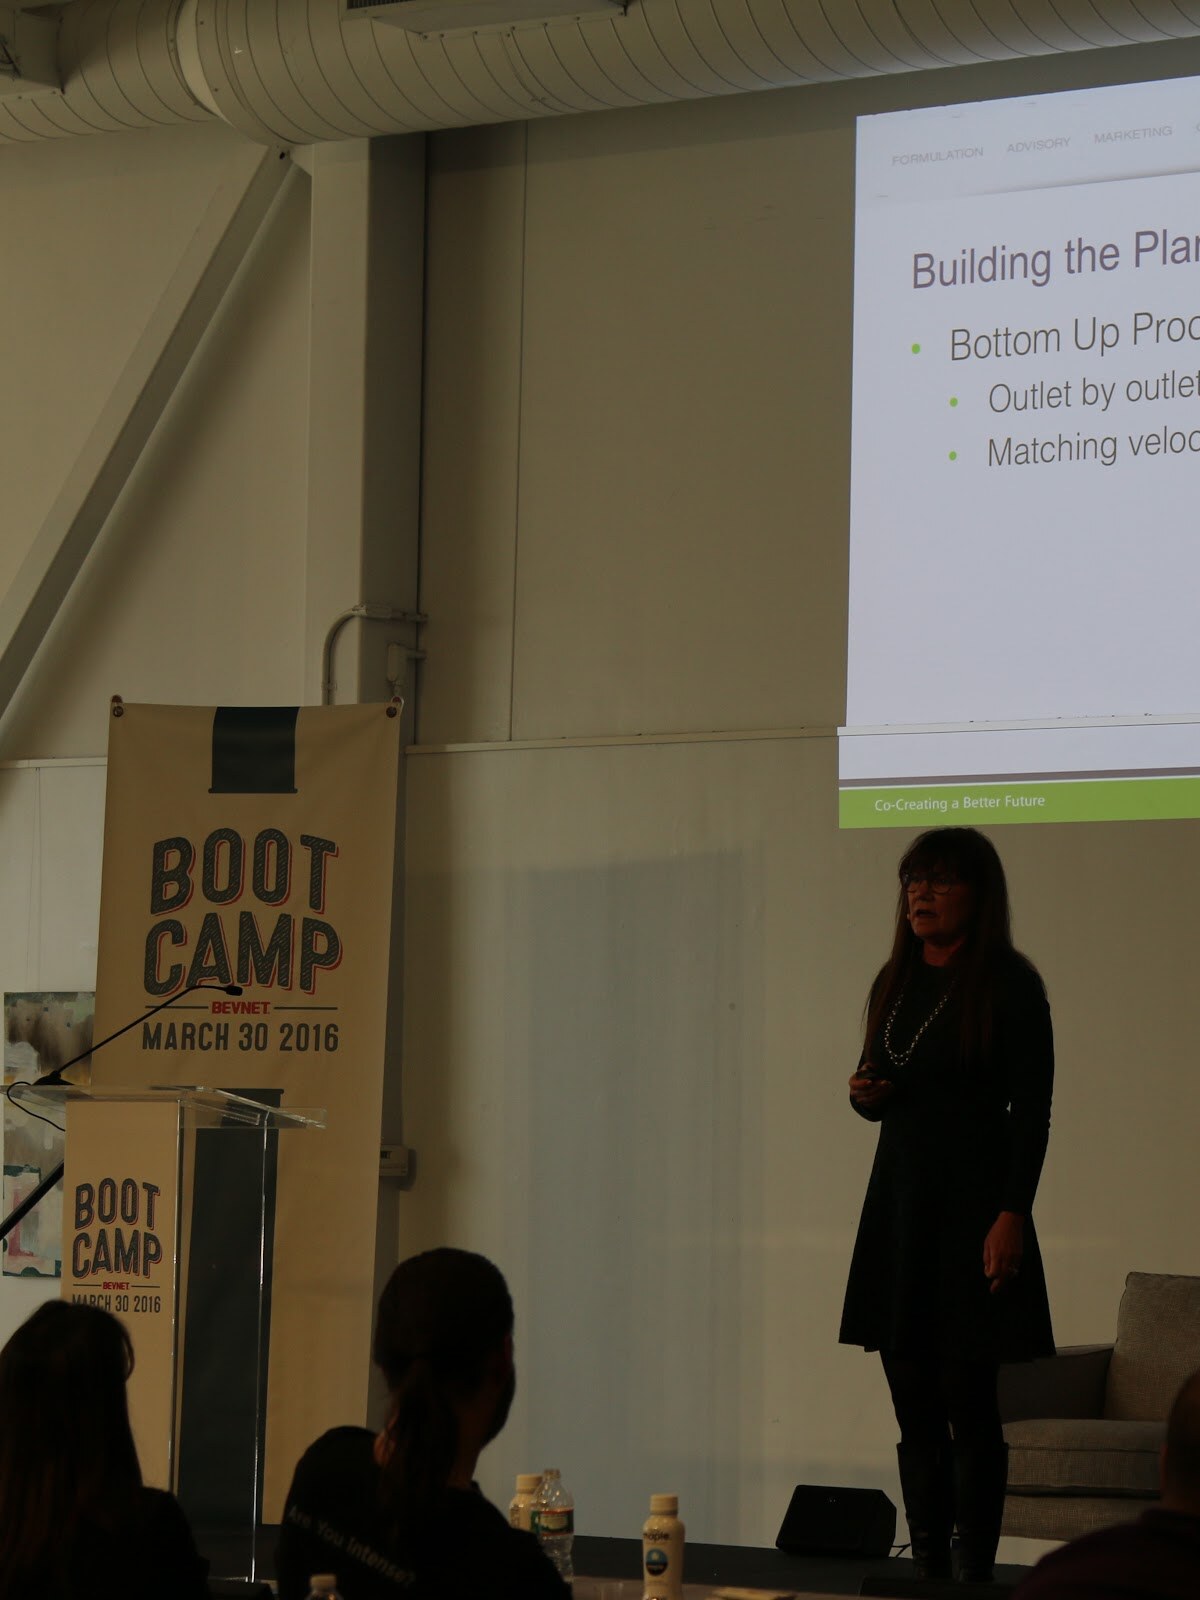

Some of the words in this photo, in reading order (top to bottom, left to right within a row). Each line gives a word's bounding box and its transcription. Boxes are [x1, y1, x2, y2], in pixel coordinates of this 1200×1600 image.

[892, 147, 983, 166] FORMULATION
[1007, 137, 1071, 152] ADVISORY
[1094, 126, 1172, 144] MARKETING
[914, 245, 1050, 289] Building
[1065, 238, 1119, 274] the
[952, 327, 1060, 360] Bottom
[1075, 317, 1119, 357] Up
[990, 381, 1071, 412] Outlet
[1083, 378, 1115, 411] by
[989, 432, 1116, 466] Matching
[875, 798, 947, 812] Co-Creating
[952, 800, 959, 808] a
[964, 797, 1001, 808] Better
[1006, 795, 1045, 807] Future
[151, 828, 339, 915] BOOT
[144, 911, 342, 996] CAMP
[211, 1001, 270, 1015] BEVNET
[142, 1023, 229, 1051] MARCH
[239, 1023, 269, 1051] 30
[279, 1023, 340, 1052] 2016
[74, 1178, 161, 1230] BOOT
[72, 1228, 162, 1278] CAMP
[103, 1282, 129, 1290] BEVNET
[115, 1295, 129, 1312] 30
[134, 1296, 160, 1313] 2016
[314, 1520, 345, 1548] You
